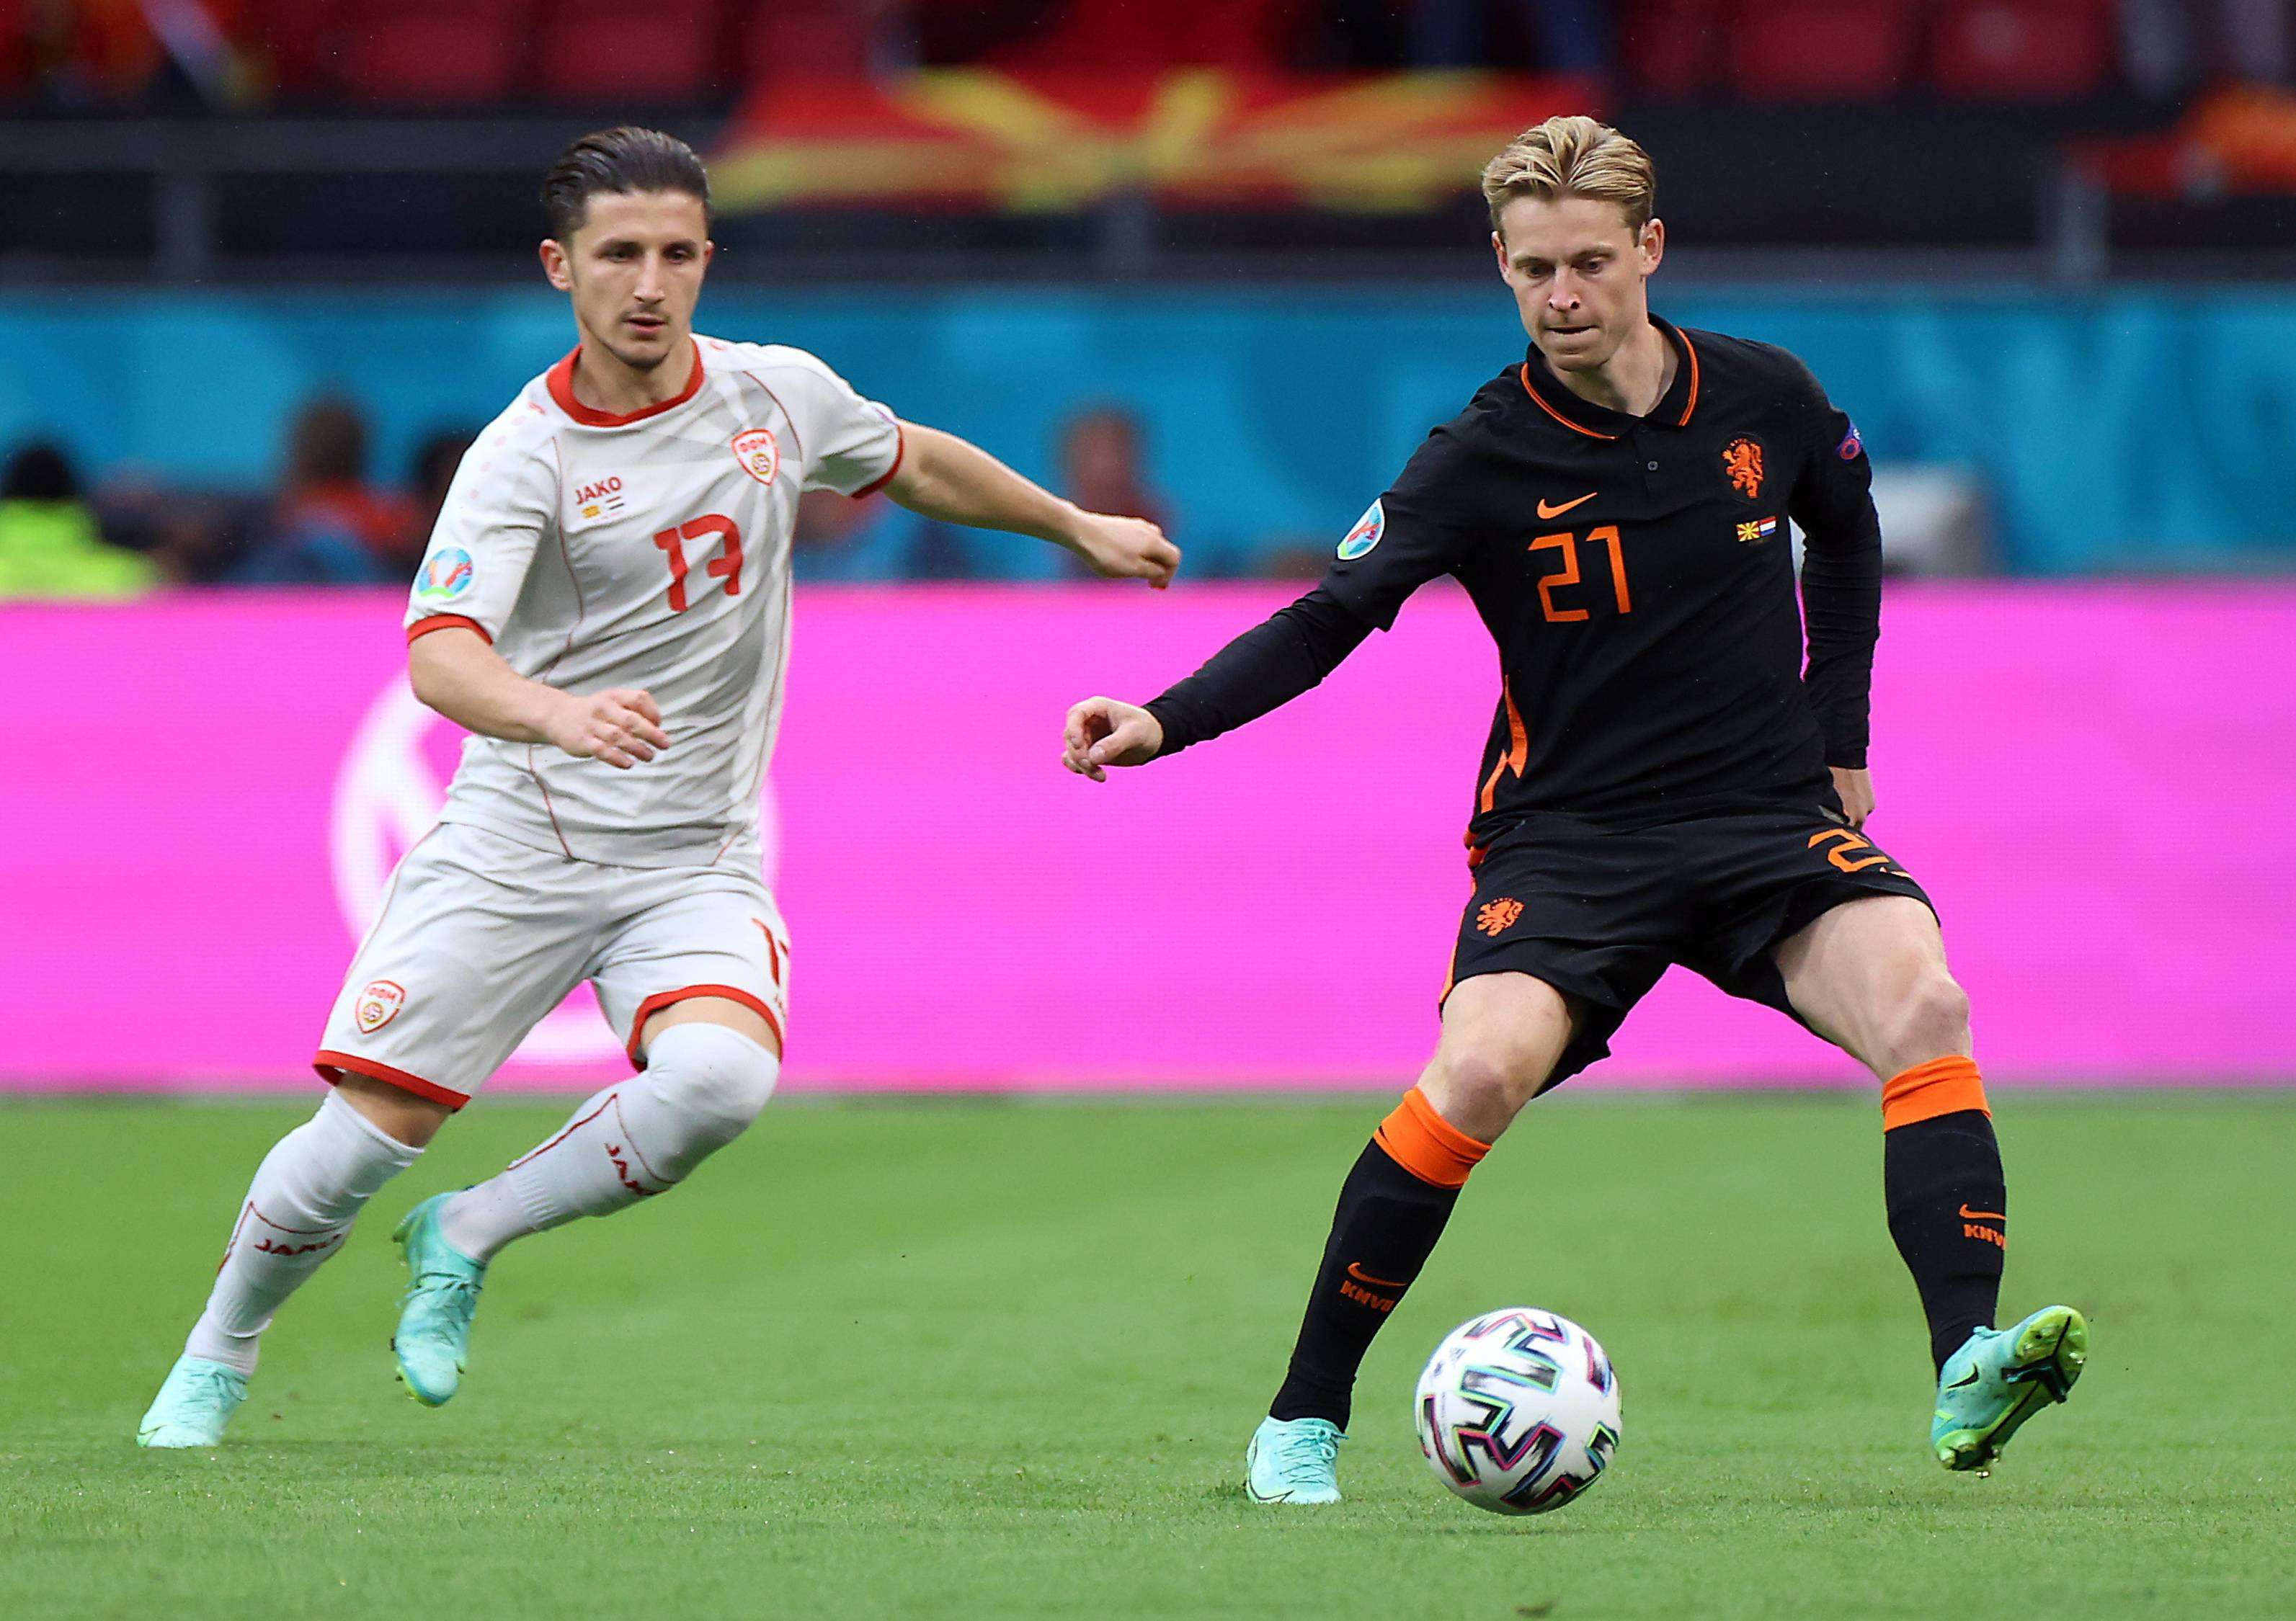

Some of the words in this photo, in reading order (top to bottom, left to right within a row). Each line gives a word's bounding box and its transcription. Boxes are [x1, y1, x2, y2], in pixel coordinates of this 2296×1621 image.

[576, 476, 622, 505] JAKO
[654, 514, 744, 612] 17
[1528, 525, 1632, 622] 21
[1807, 828, 1890, 872] 2
[752, 917, 788, 988] 1
[1964, 1223, 2007, 1251] KNV
